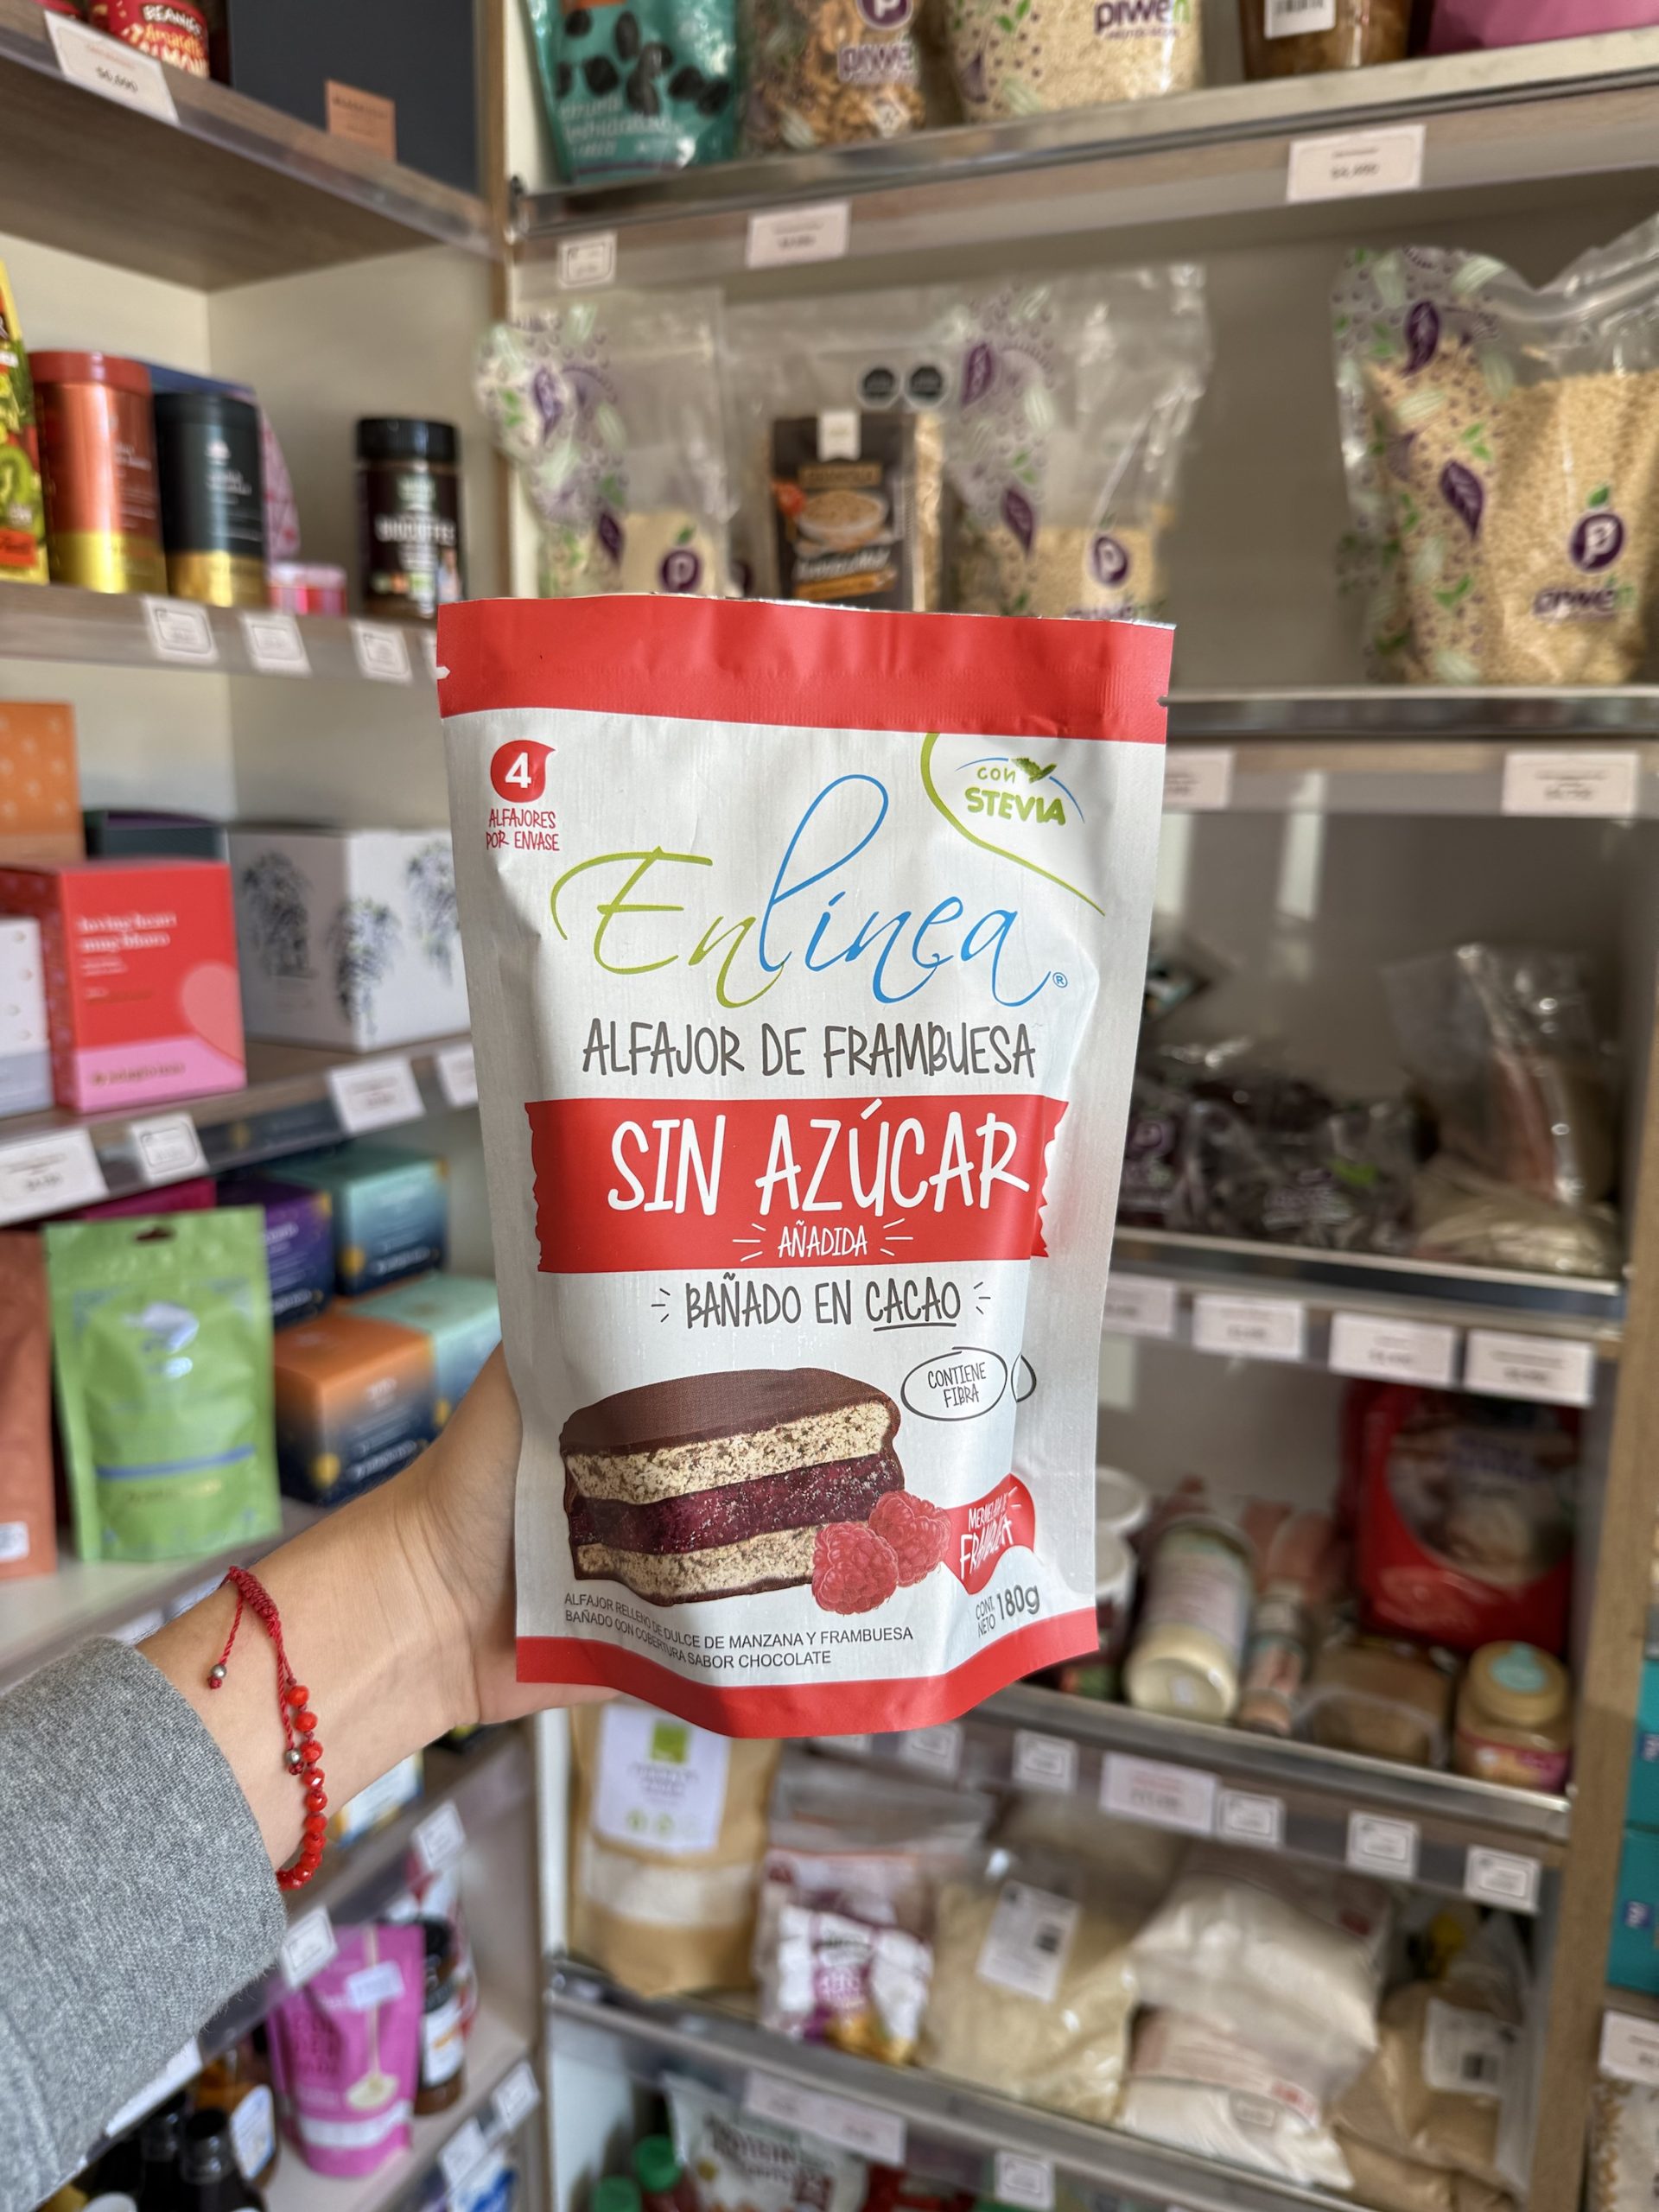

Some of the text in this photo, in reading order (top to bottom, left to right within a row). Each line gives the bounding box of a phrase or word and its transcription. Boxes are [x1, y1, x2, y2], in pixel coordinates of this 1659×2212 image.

[505, 752, 532, 789] 4
[488, 808, 556, 830] ALFAJORES
[964, 786, 1066, 826] STEVIA
[486, 830, 560, 851] POR ENVASE
[582, 1017, 1037, 1078] ALFAJOR DE FRAMBUESA
[607, 1098, 1031, 1217] SIN AZÚCAR
[777, 1219, 868, 1258] AÑADIDA
[684, 1271, 962, 1330] BAÑADO EN CACAO
[926, 1362, 987, 1389] CONTIENE
[943, 1384, 980, 1408] FIBRA
[564, 1592, 913, 1649] ALFAJOR RELLENO DE DULCE DE MANZANA Y FRAMBUESA
[996, 1584, 1040, 1620] 180g
[565, 1608, 832, 1669] BAÑADO CON COBERTURA SABOR CHOCOLATE
[977, 1613, 996, 1638] NETO
